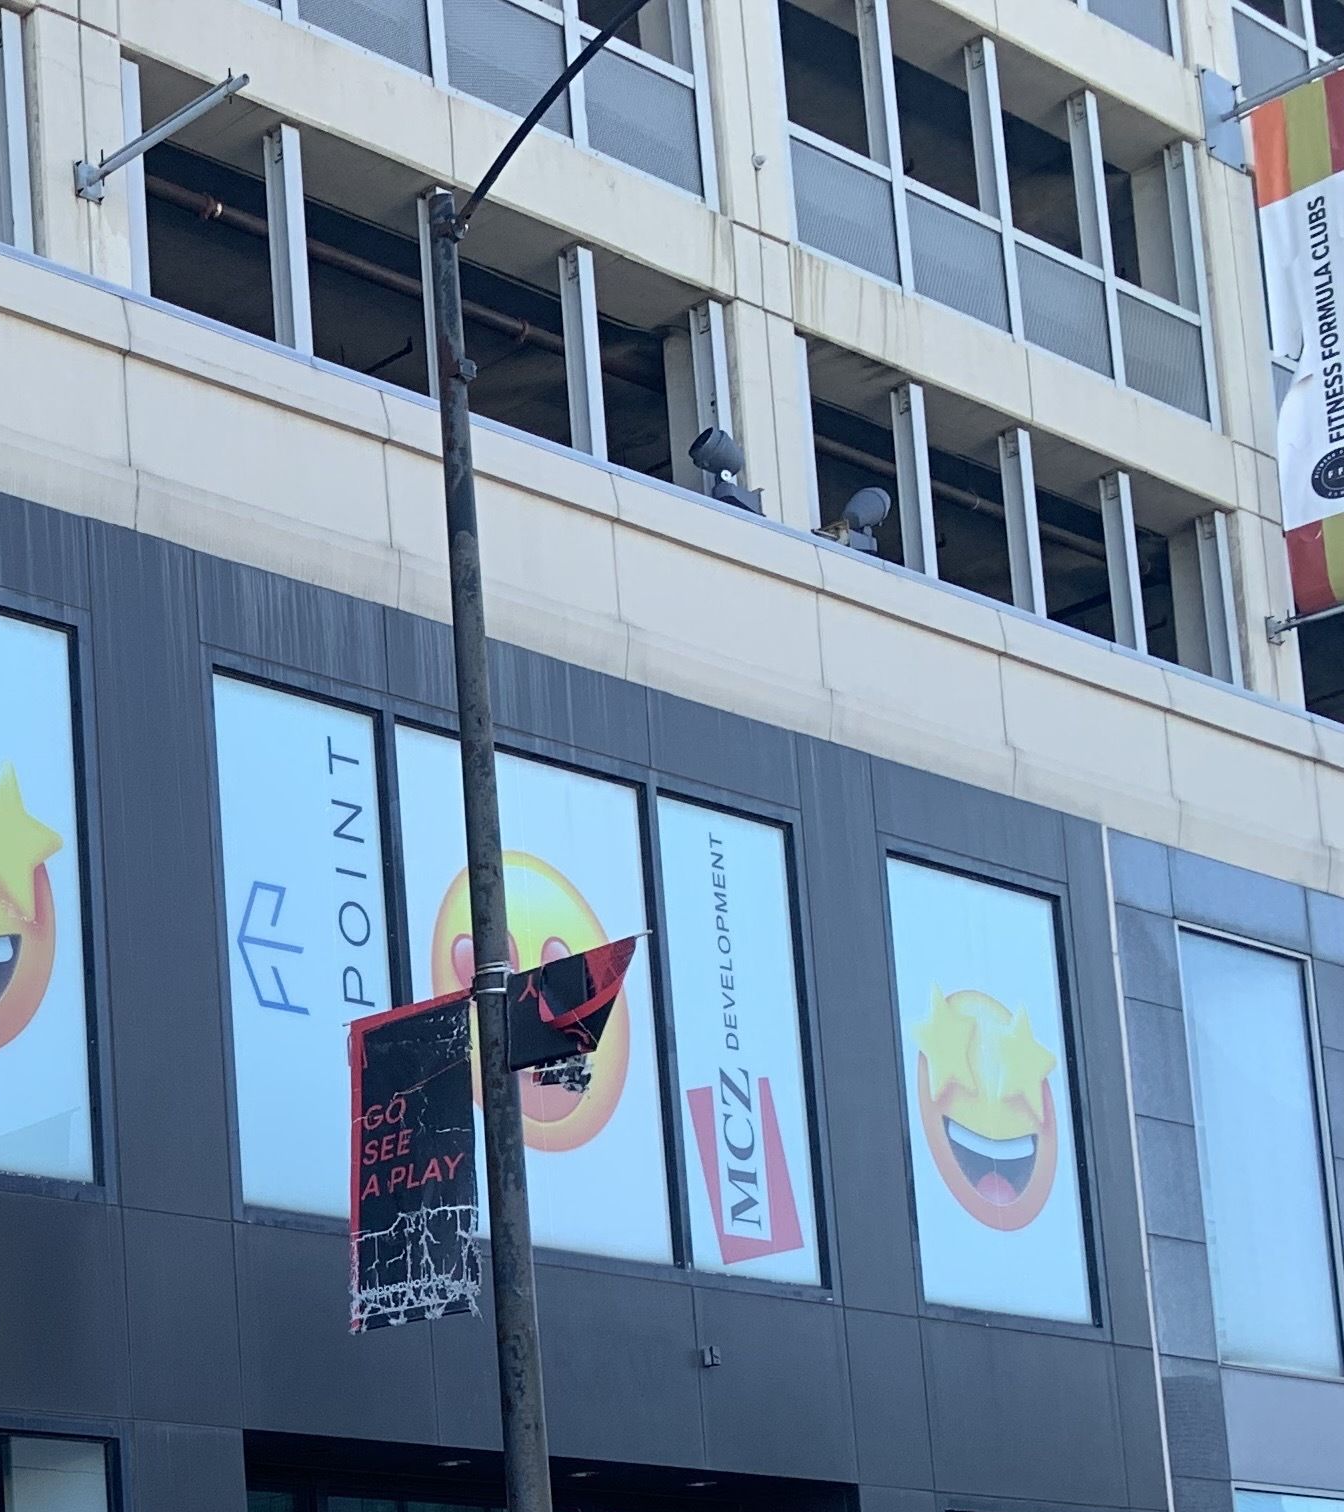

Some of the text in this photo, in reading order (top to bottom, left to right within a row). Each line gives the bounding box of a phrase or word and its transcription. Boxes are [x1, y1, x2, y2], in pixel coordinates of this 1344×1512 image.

[1307, 196, 1330, 261] CLUBS
[1314, 261, 1340, 361] FORMULA
[1323, 362, 1344, 443] FITNESS
[327, 735, 376, 1007] POINT
[708, 832, 762, 1231] MCZ DEVELOPMENT
[362, 1129, 414, 1165] SEE
[364, 1096, 407, 1130] GO
[361, 1152, 465, 1200] A PLAY
